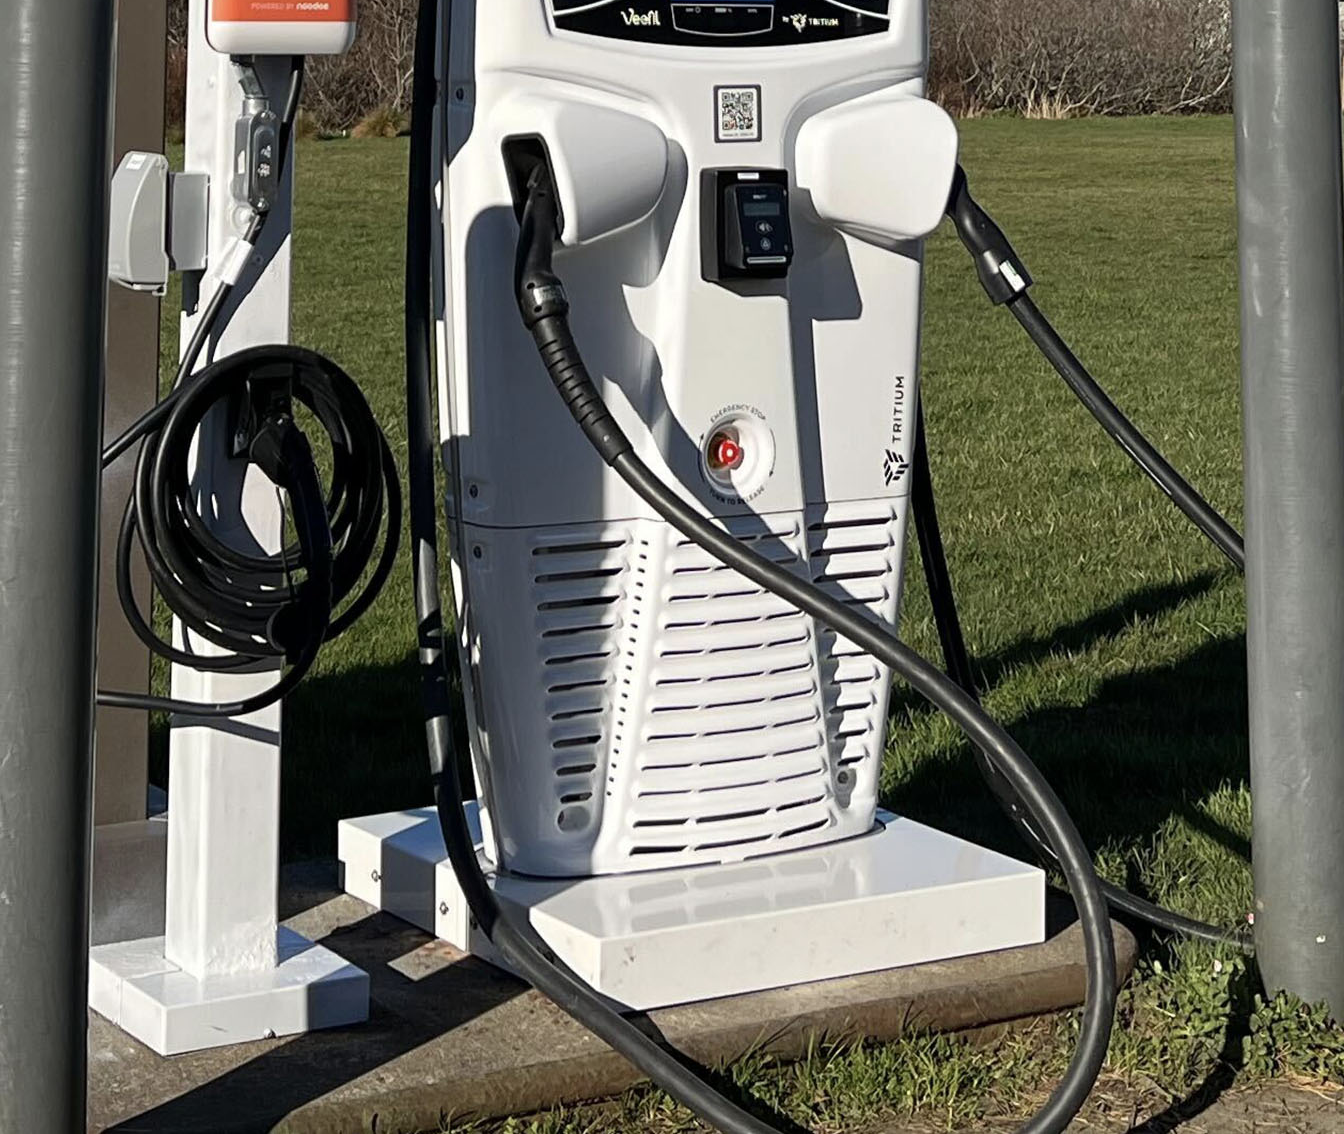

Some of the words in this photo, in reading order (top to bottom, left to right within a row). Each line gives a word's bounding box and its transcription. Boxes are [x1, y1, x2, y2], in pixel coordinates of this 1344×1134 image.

[296, 1, 330, 11] noodoe
[710, 404, 749, 423] EMERGENCY
[751, 407, 766, 420] STOP
[892, 375, 904, 444] TRITIUM
